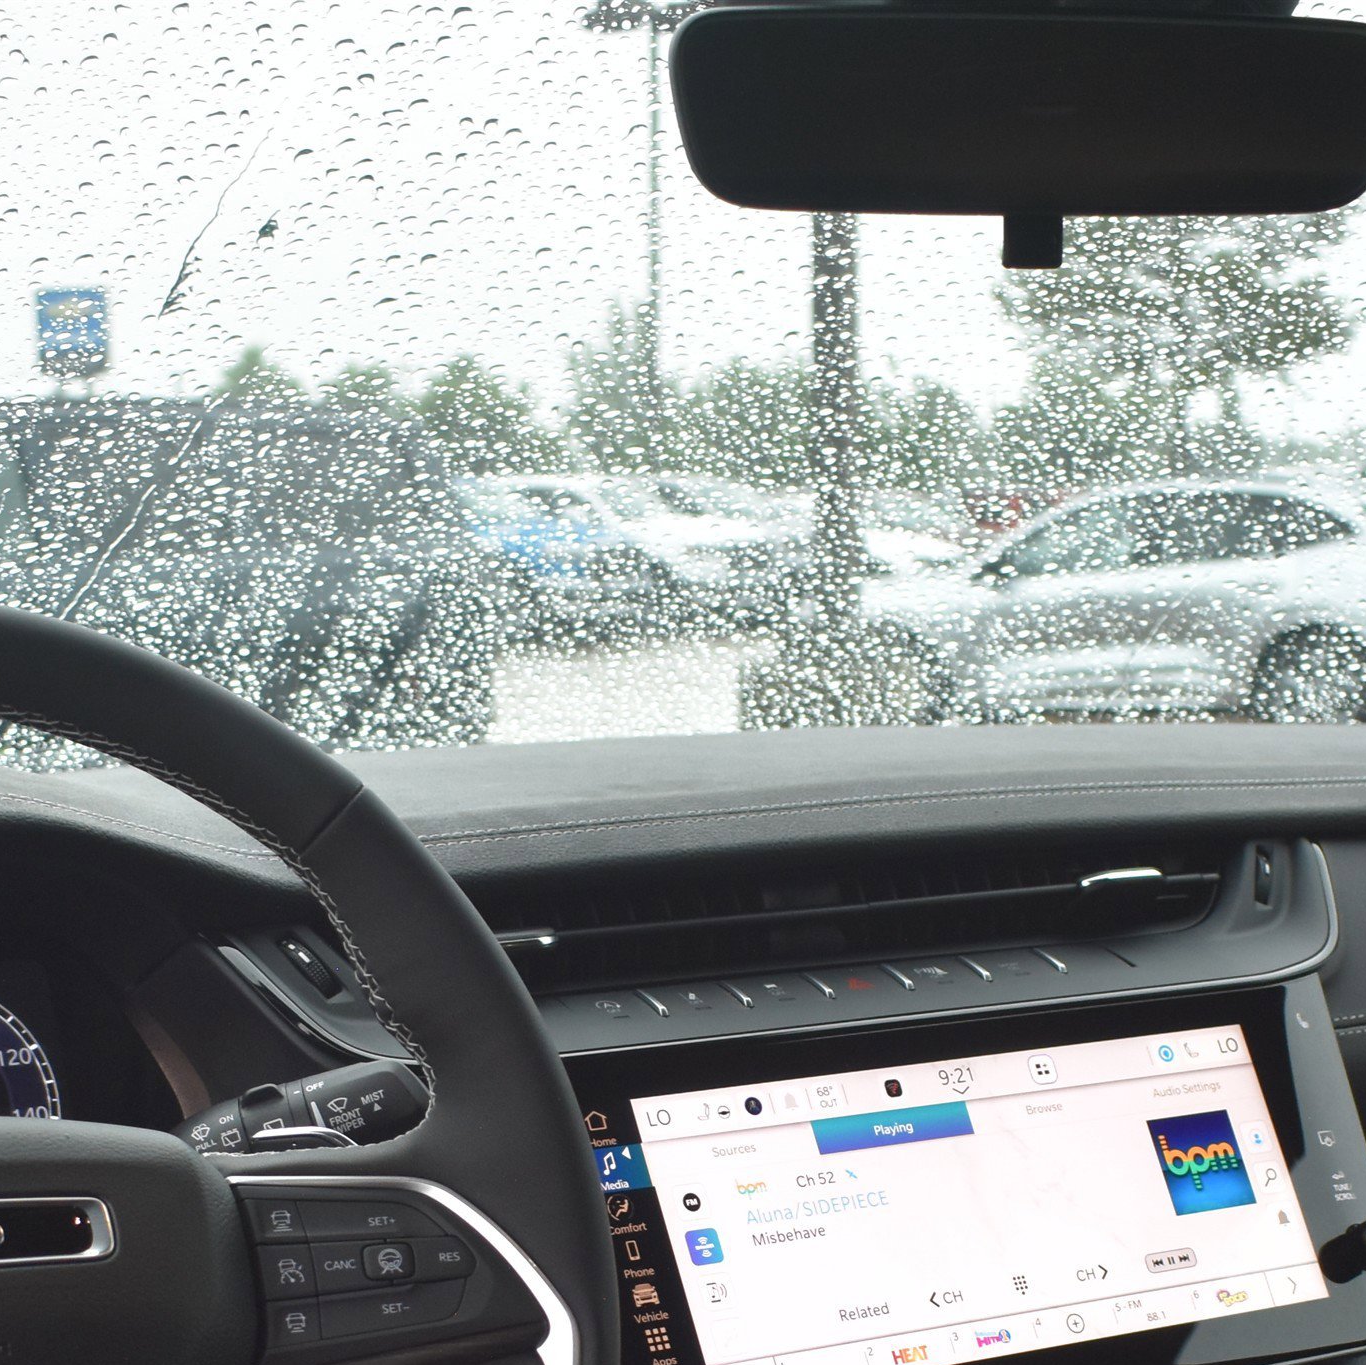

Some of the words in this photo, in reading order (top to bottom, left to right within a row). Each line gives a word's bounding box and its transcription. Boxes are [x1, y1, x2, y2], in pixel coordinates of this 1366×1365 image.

[1217, 1037, 1239, 1054] LO
[938, 1067, 974, 1086] 9:21
[305, 1080, 325, 1092] OFF
[1153, 1084, 1180, 1099] Audio
[1184, 1080, 1221, 1095] Settings
[360, 1089, 385, 1106] MIST
[820, 1098, 838, 1109] OUT
[1026, 1102, 1063, 1116] Browse
[218, 1114, 234, 1125] ON
[329, 1107, 362, 1127] FRONT
[646, 1109, 671, 1127] LO
[873, 1121, 914, 1136] Playing
[195, 1139, 217, 1151] PULL
[712, 1144, 756, 1158] Sources
[1158, 1134, 1239, 1192] bpm
[601, 1179, 629, 1191] Media
[796, 1174, 816, 1188] Ch
[818, 1171, 836, 1184] 52
[737, 1180, 767, 1200] bpm
[686, 1197, 698, 1207] FM
[747, 1190, 889, 1224] Aluna/SIDEPIECE
[368, 1215, 396, 1228] SET+
[610, 1222, 647, 1236] Comfort
[752, 1226, 826, 1246] Misbehave
[438, 1251, 461, 1263] RES
[324, 1258, 357, 1271] CANC
[624, 1266, 655, 1279] Phone
[1076, 1268, 1096, 1282] CH
[943, 1290, 964, 1304] CH
[634, 1310, 669, 1323] Vehicle
[839, 1302, 890, 1322] Related
[1147, 1311, 1166, 1322] 88.1
[891, 1344, 928, 1365] HEAT
